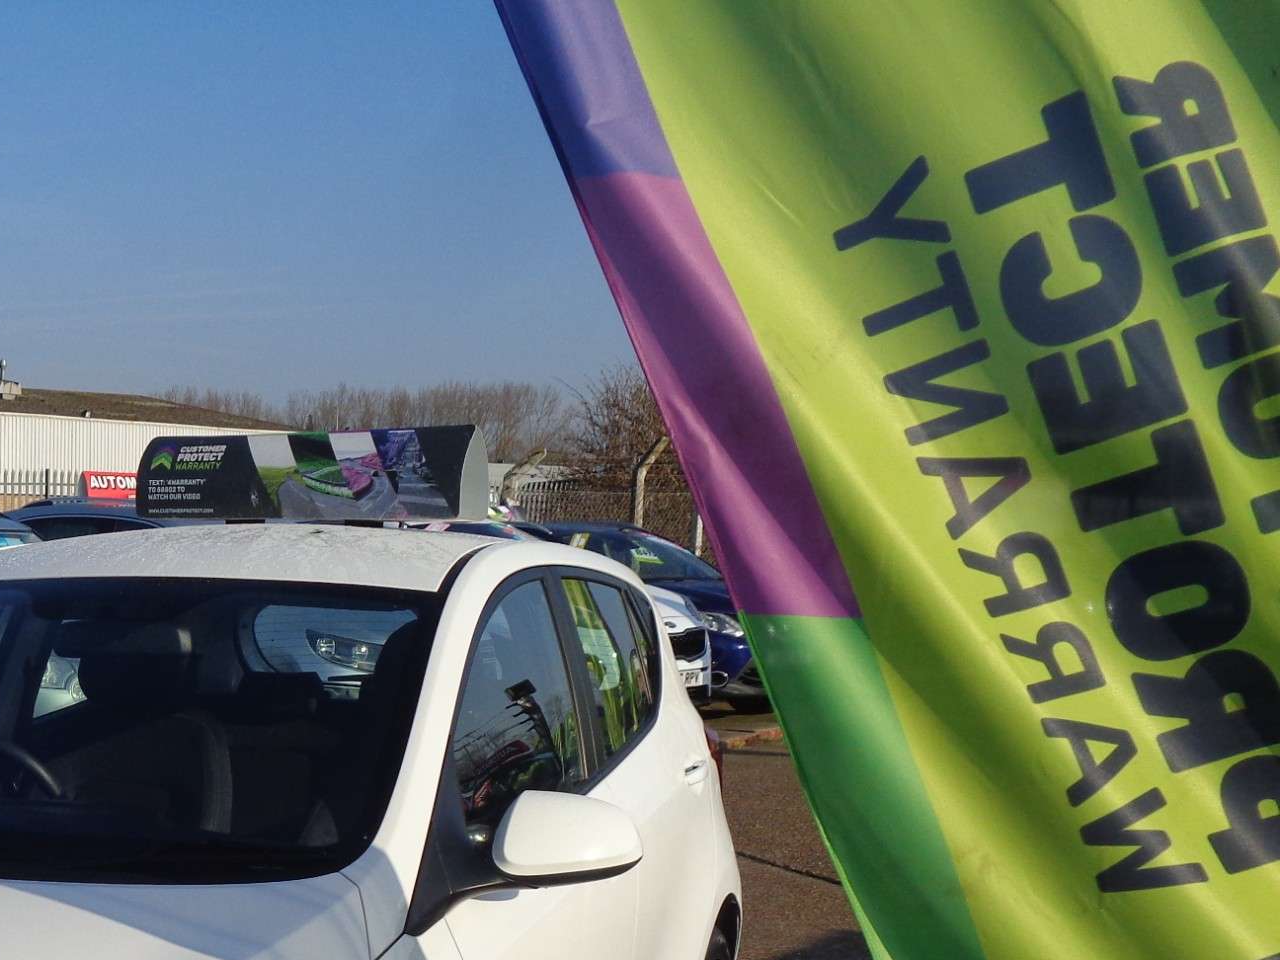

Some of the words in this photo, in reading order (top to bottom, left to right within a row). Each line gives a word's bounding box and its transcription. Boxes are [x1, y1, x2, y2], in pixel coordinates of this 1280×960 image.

[180, 445, 227, 453] CUSTOMER
[177, 452, 225, 462] PROTECT
[175, 461, 223, 470] WARRANTY
